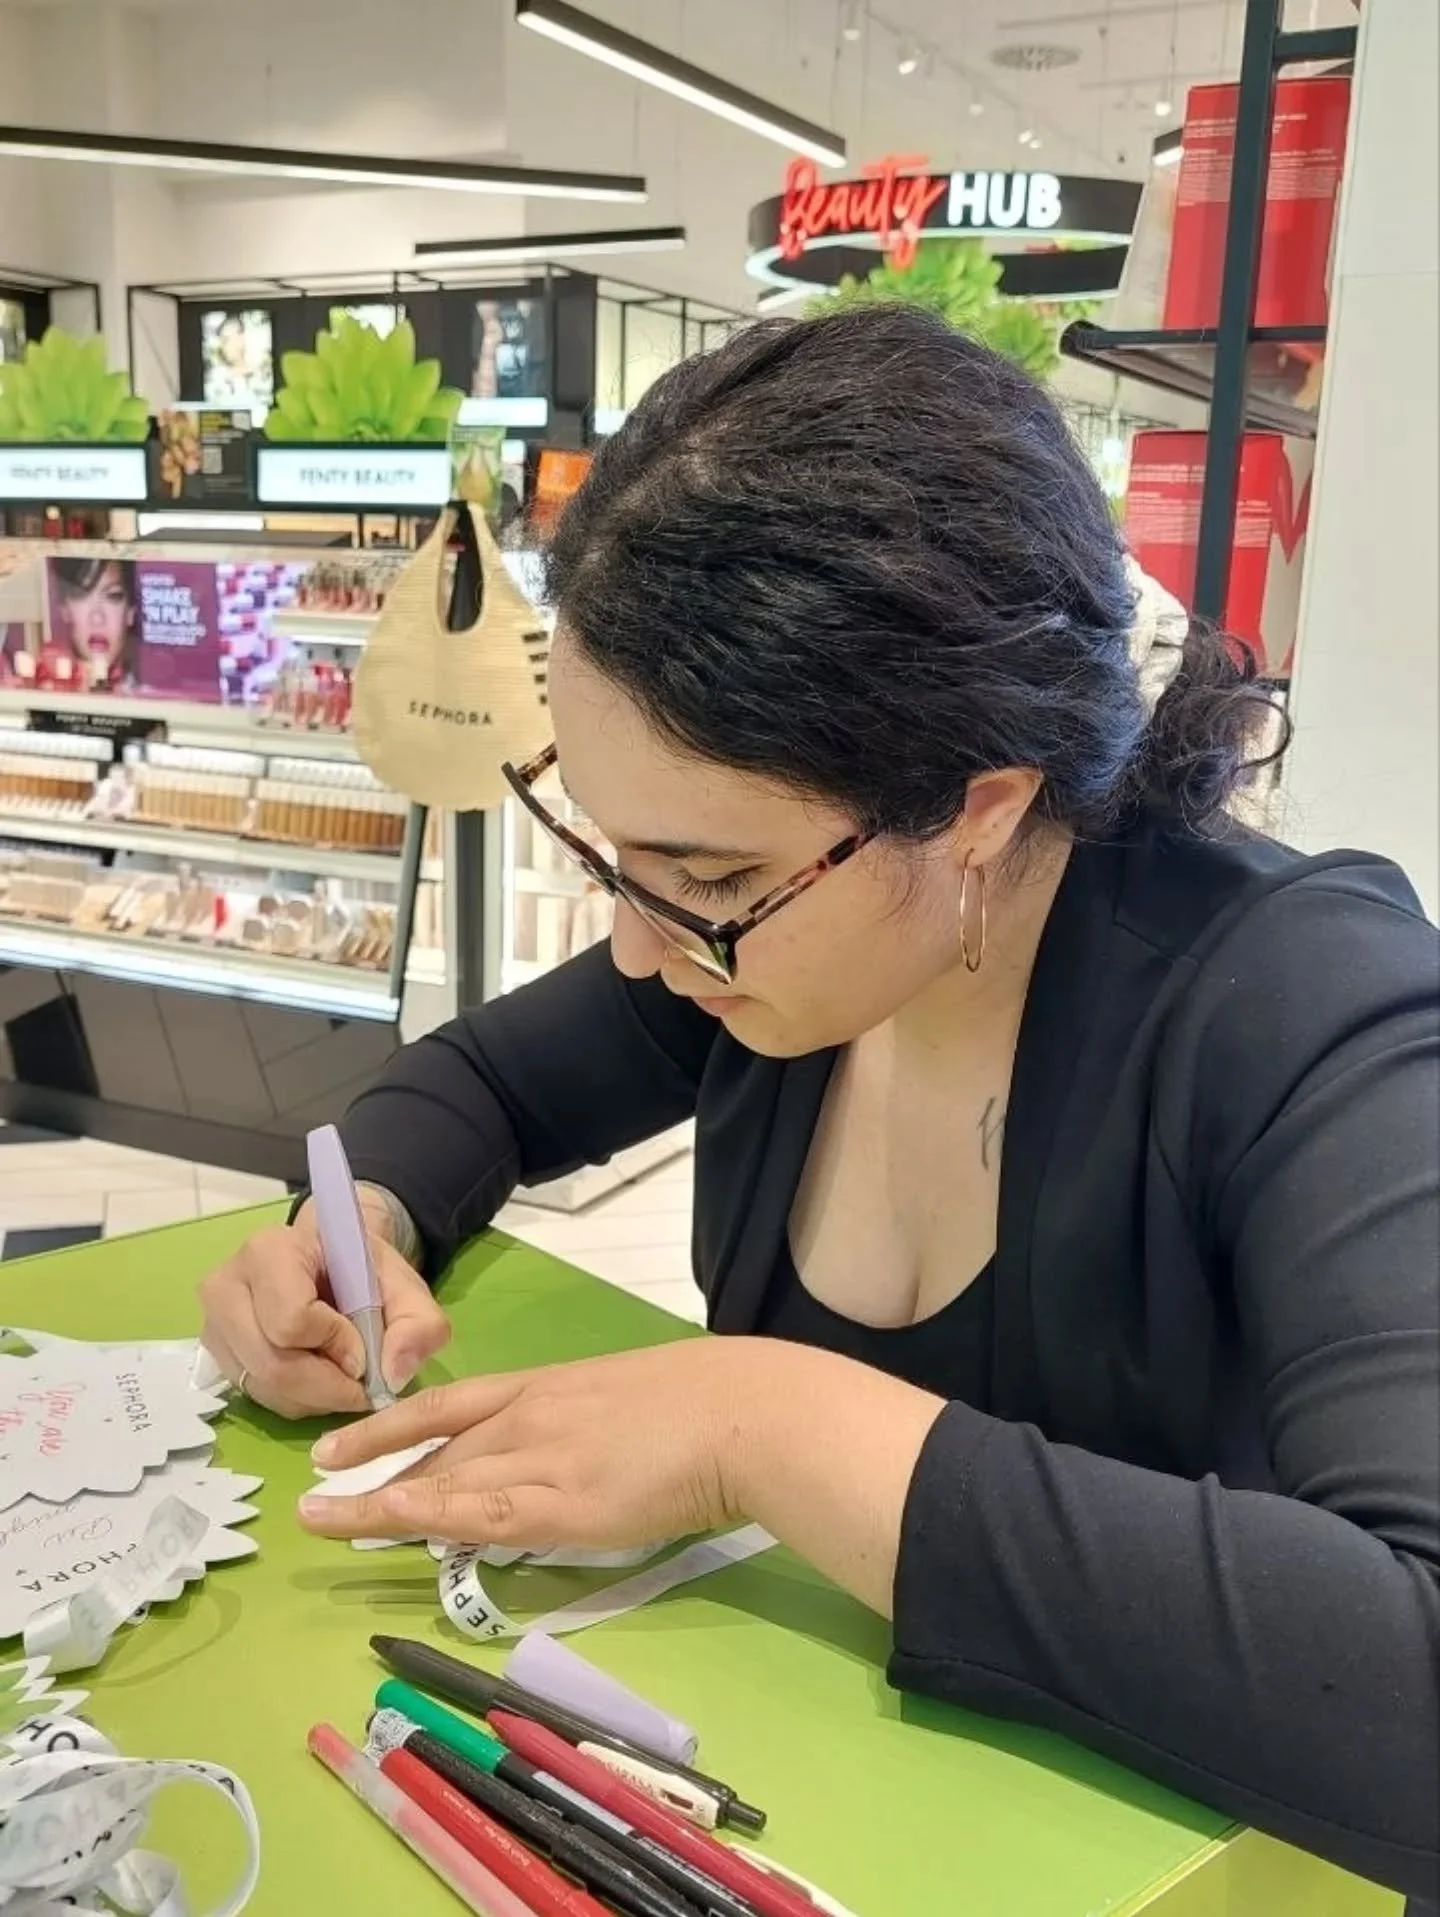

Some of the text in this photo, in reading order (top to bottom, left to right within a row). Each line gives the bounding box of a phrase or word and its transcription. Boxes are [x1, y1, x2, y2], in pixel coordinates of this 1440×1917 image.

[778, 156, 1062, 272] Beauty HUB
[408, 700, 492, 725] SEPHORA
[115, 1372, 153, 1433] SEPHORA
[20, 1542, 138, 1593] HORA
